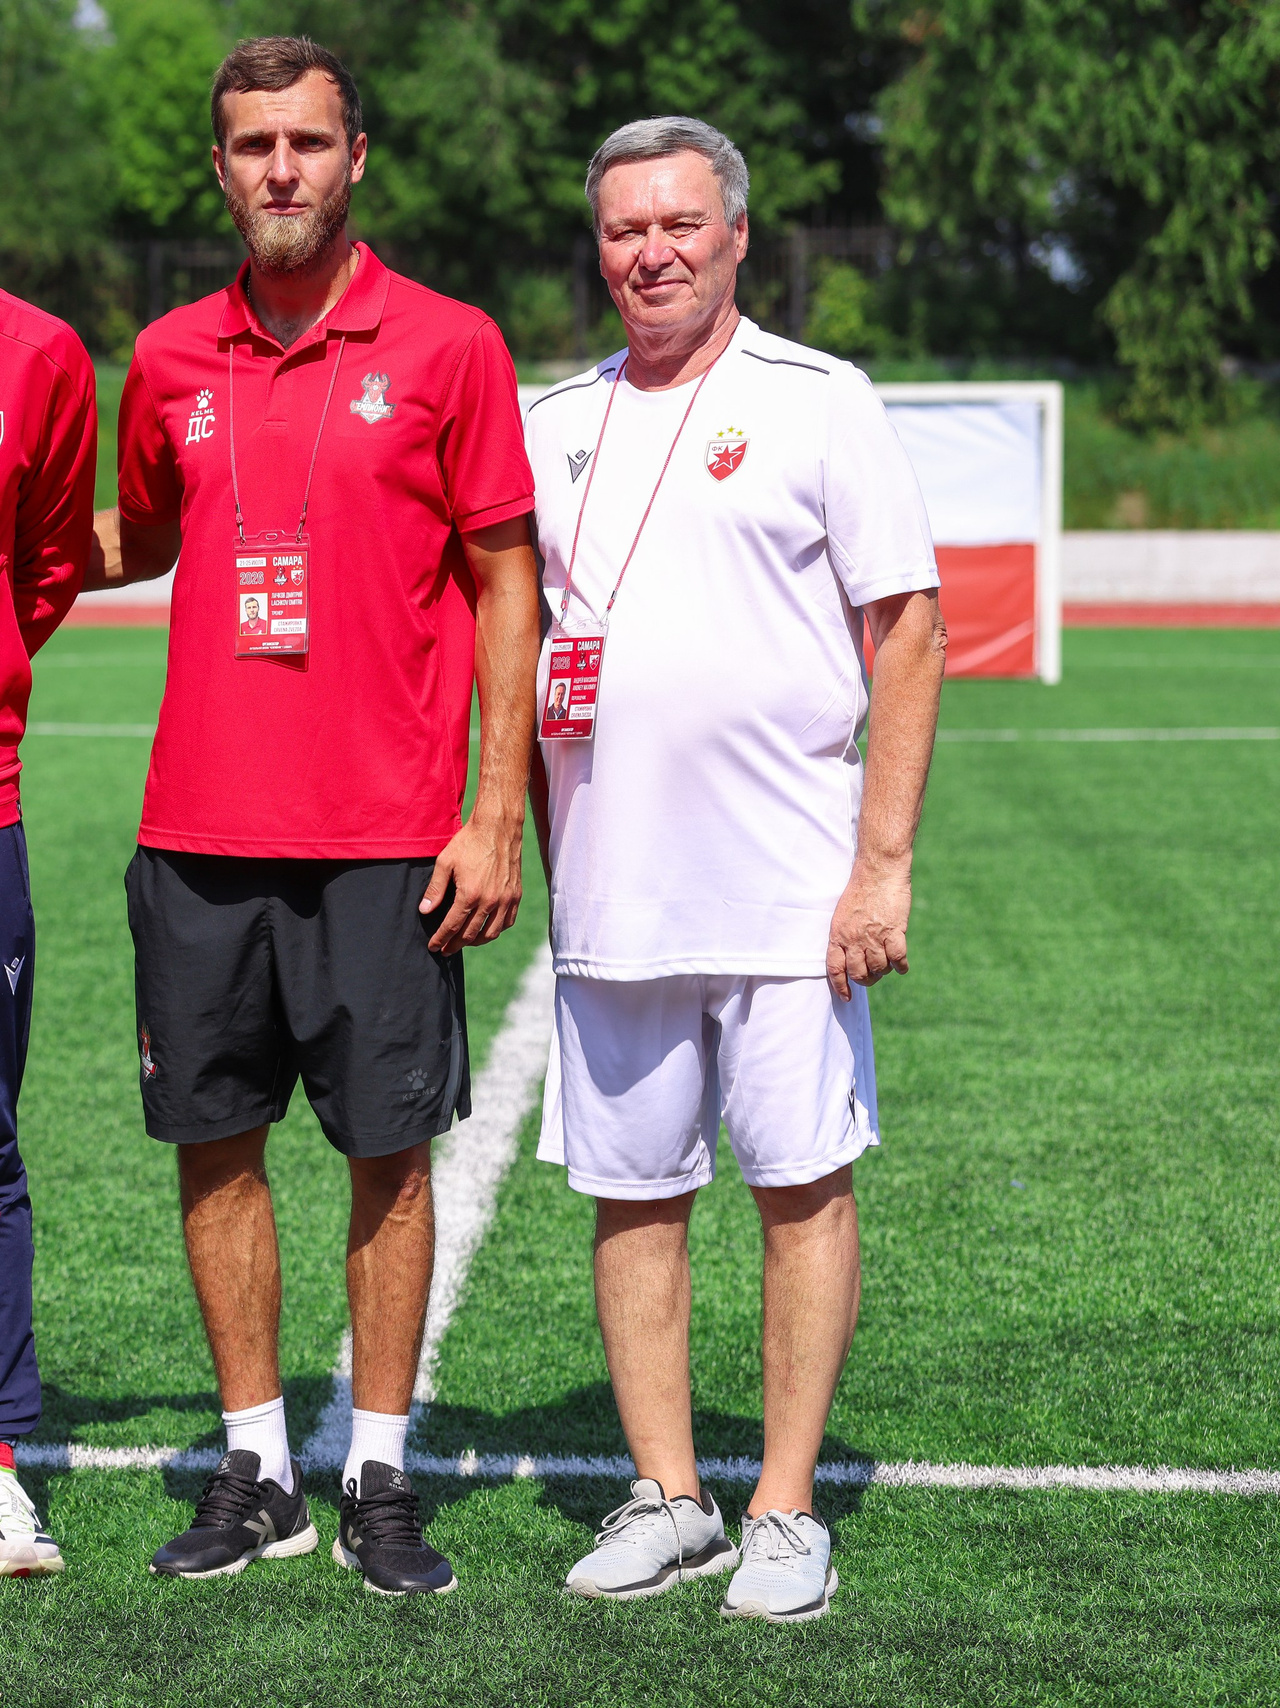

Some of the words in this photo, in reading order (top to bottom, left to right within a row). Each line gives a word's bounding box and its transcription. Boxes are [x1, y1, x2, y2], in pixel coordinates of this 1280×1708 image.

[191, 408, 214, 416] KELME
[185, 415, 216, 445] ДС
[272, 556, 303, 566] САМАРА
[577, 640, 600, 651] САМАРА
[402, 1087, 437, 1101] KELME
